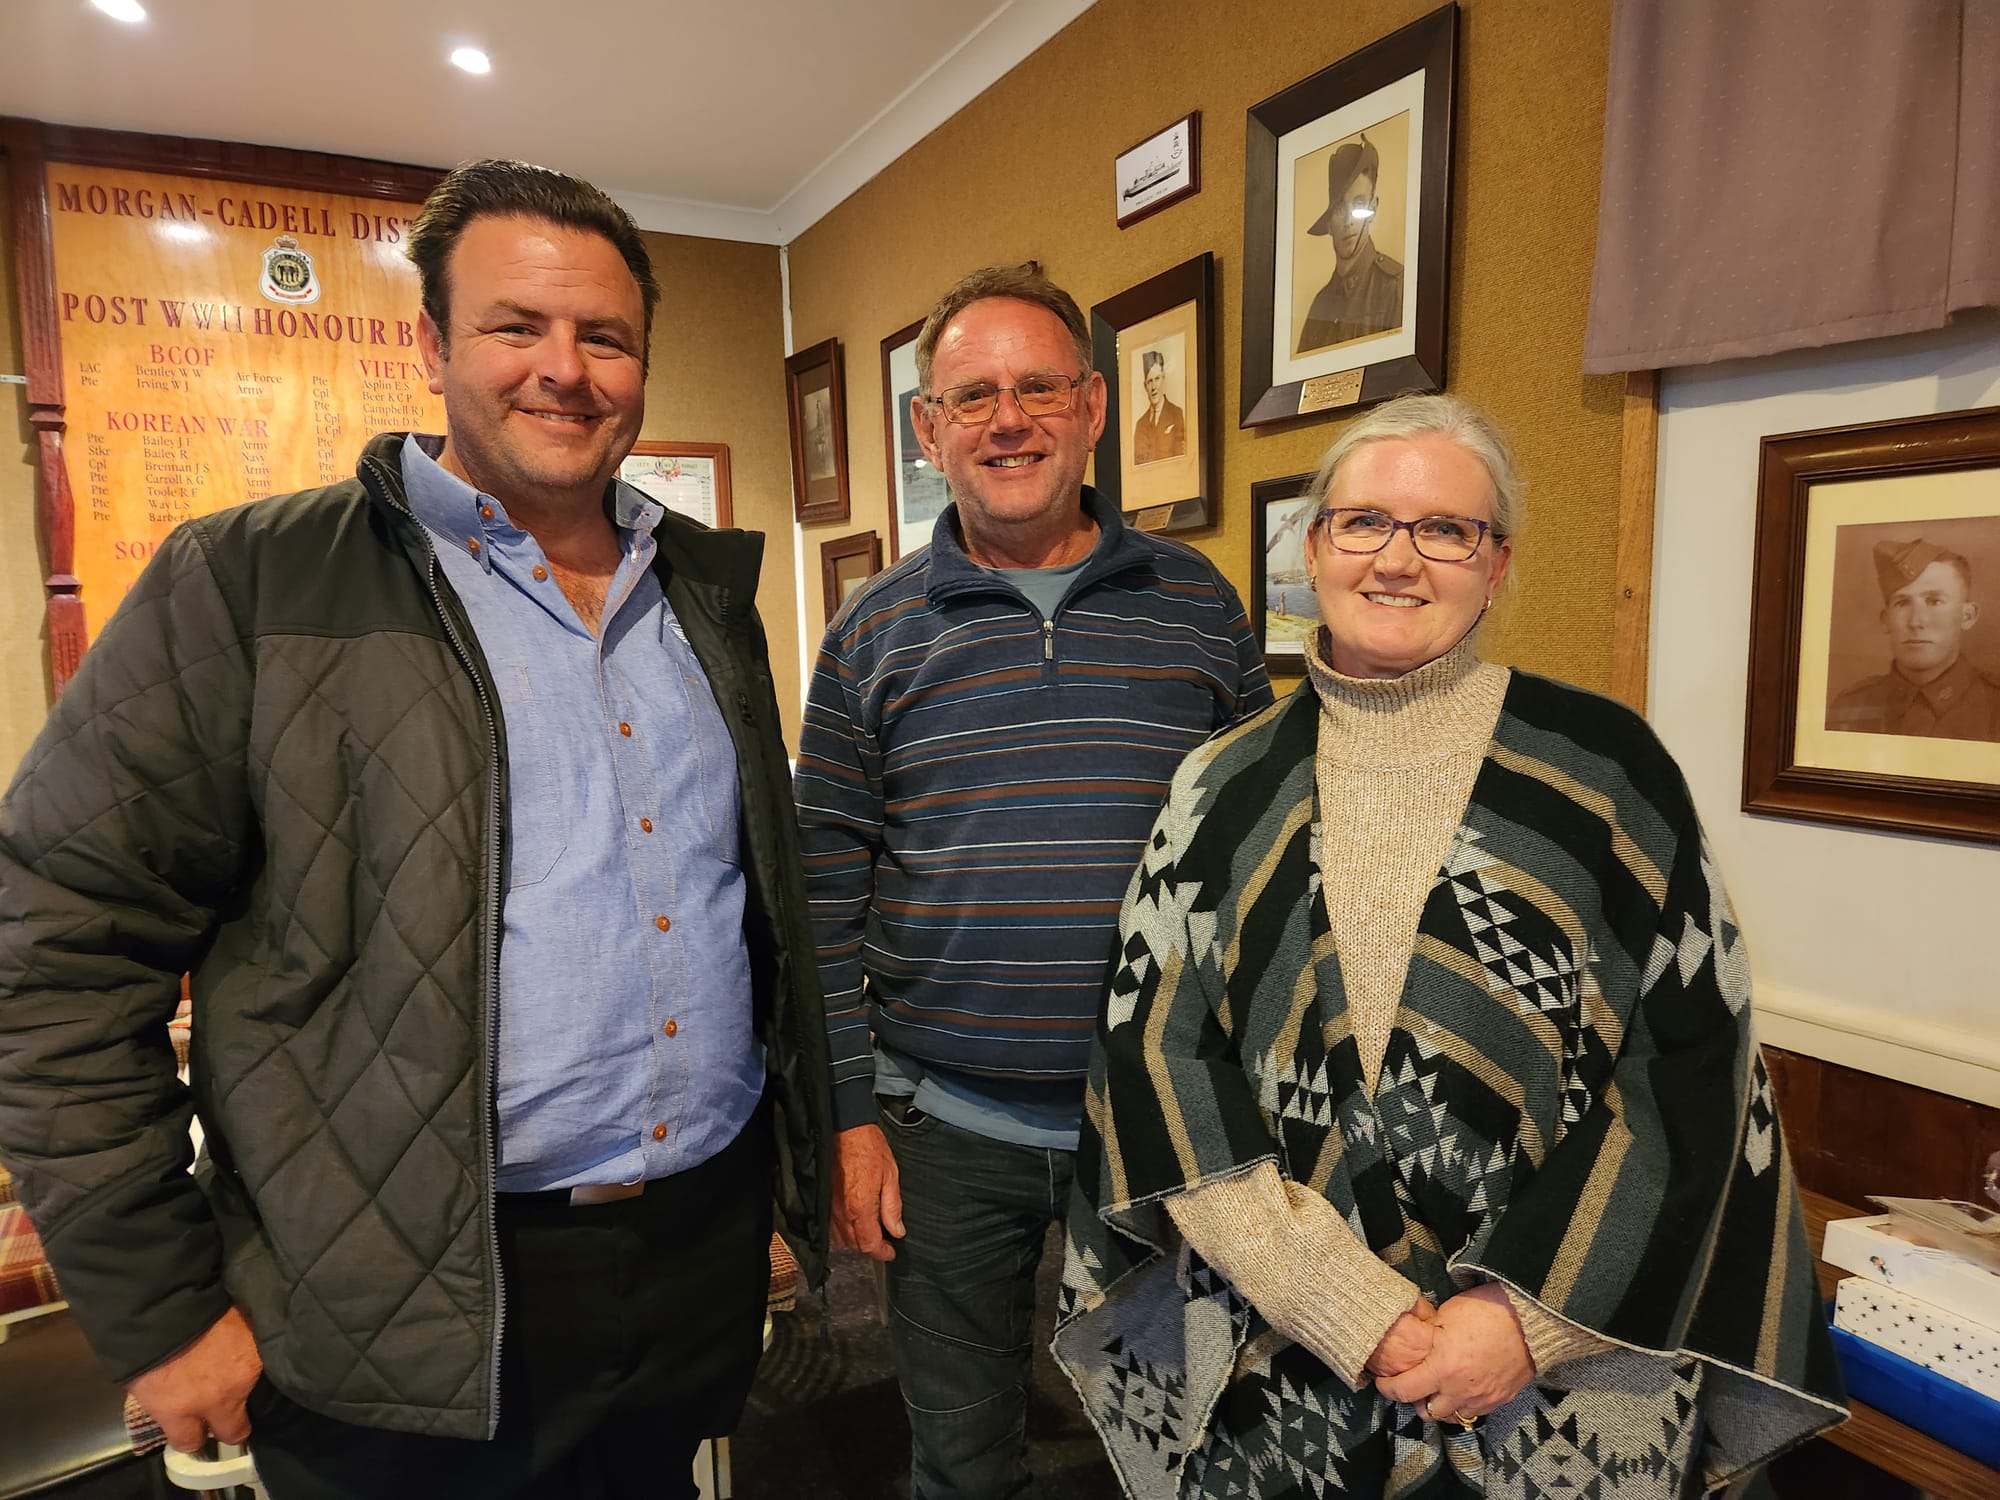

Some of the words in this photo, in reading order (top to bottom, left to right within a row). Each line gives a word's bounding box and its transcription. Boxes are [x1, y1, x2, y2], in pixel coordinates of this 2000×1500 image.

[56, 182, 336, 237] MORGAN-CADELL
[62, 293, 148, 326] POST
[254, 308, 388, 345] HONOUR
[151, 344, 214, 366] BCOF
[136, 365, 176, 378] Bentley
[236, 371, 250, 381] Air
[253, 372, 282, 383] Force
[312, 375, 328, 386] Pte
[137, 378, 169, 392] Irving
[237, 384, 264, 397] Army
[313, 388, 329, 400] Cpl
[363, 391, 384, 402] Beer
[314, 400, 330, 411] Pte
[363, 403, 408, 417] Campbell
[106, 411, 206, 434] KOREAN
[216, 417, 270, 438] WAR
[364, 415, 399, 426] Church
[143, 435, 175, 448] Bailey
[241, 440, 269, 453] Army
[144, 448, 175, 461] Bailey
[145, 461, 192, 473] Brennan
[243, 464, 271, 477] Army
[146, 474, 182, 485] Carroll
[147, 486, 177, 497] Toole
